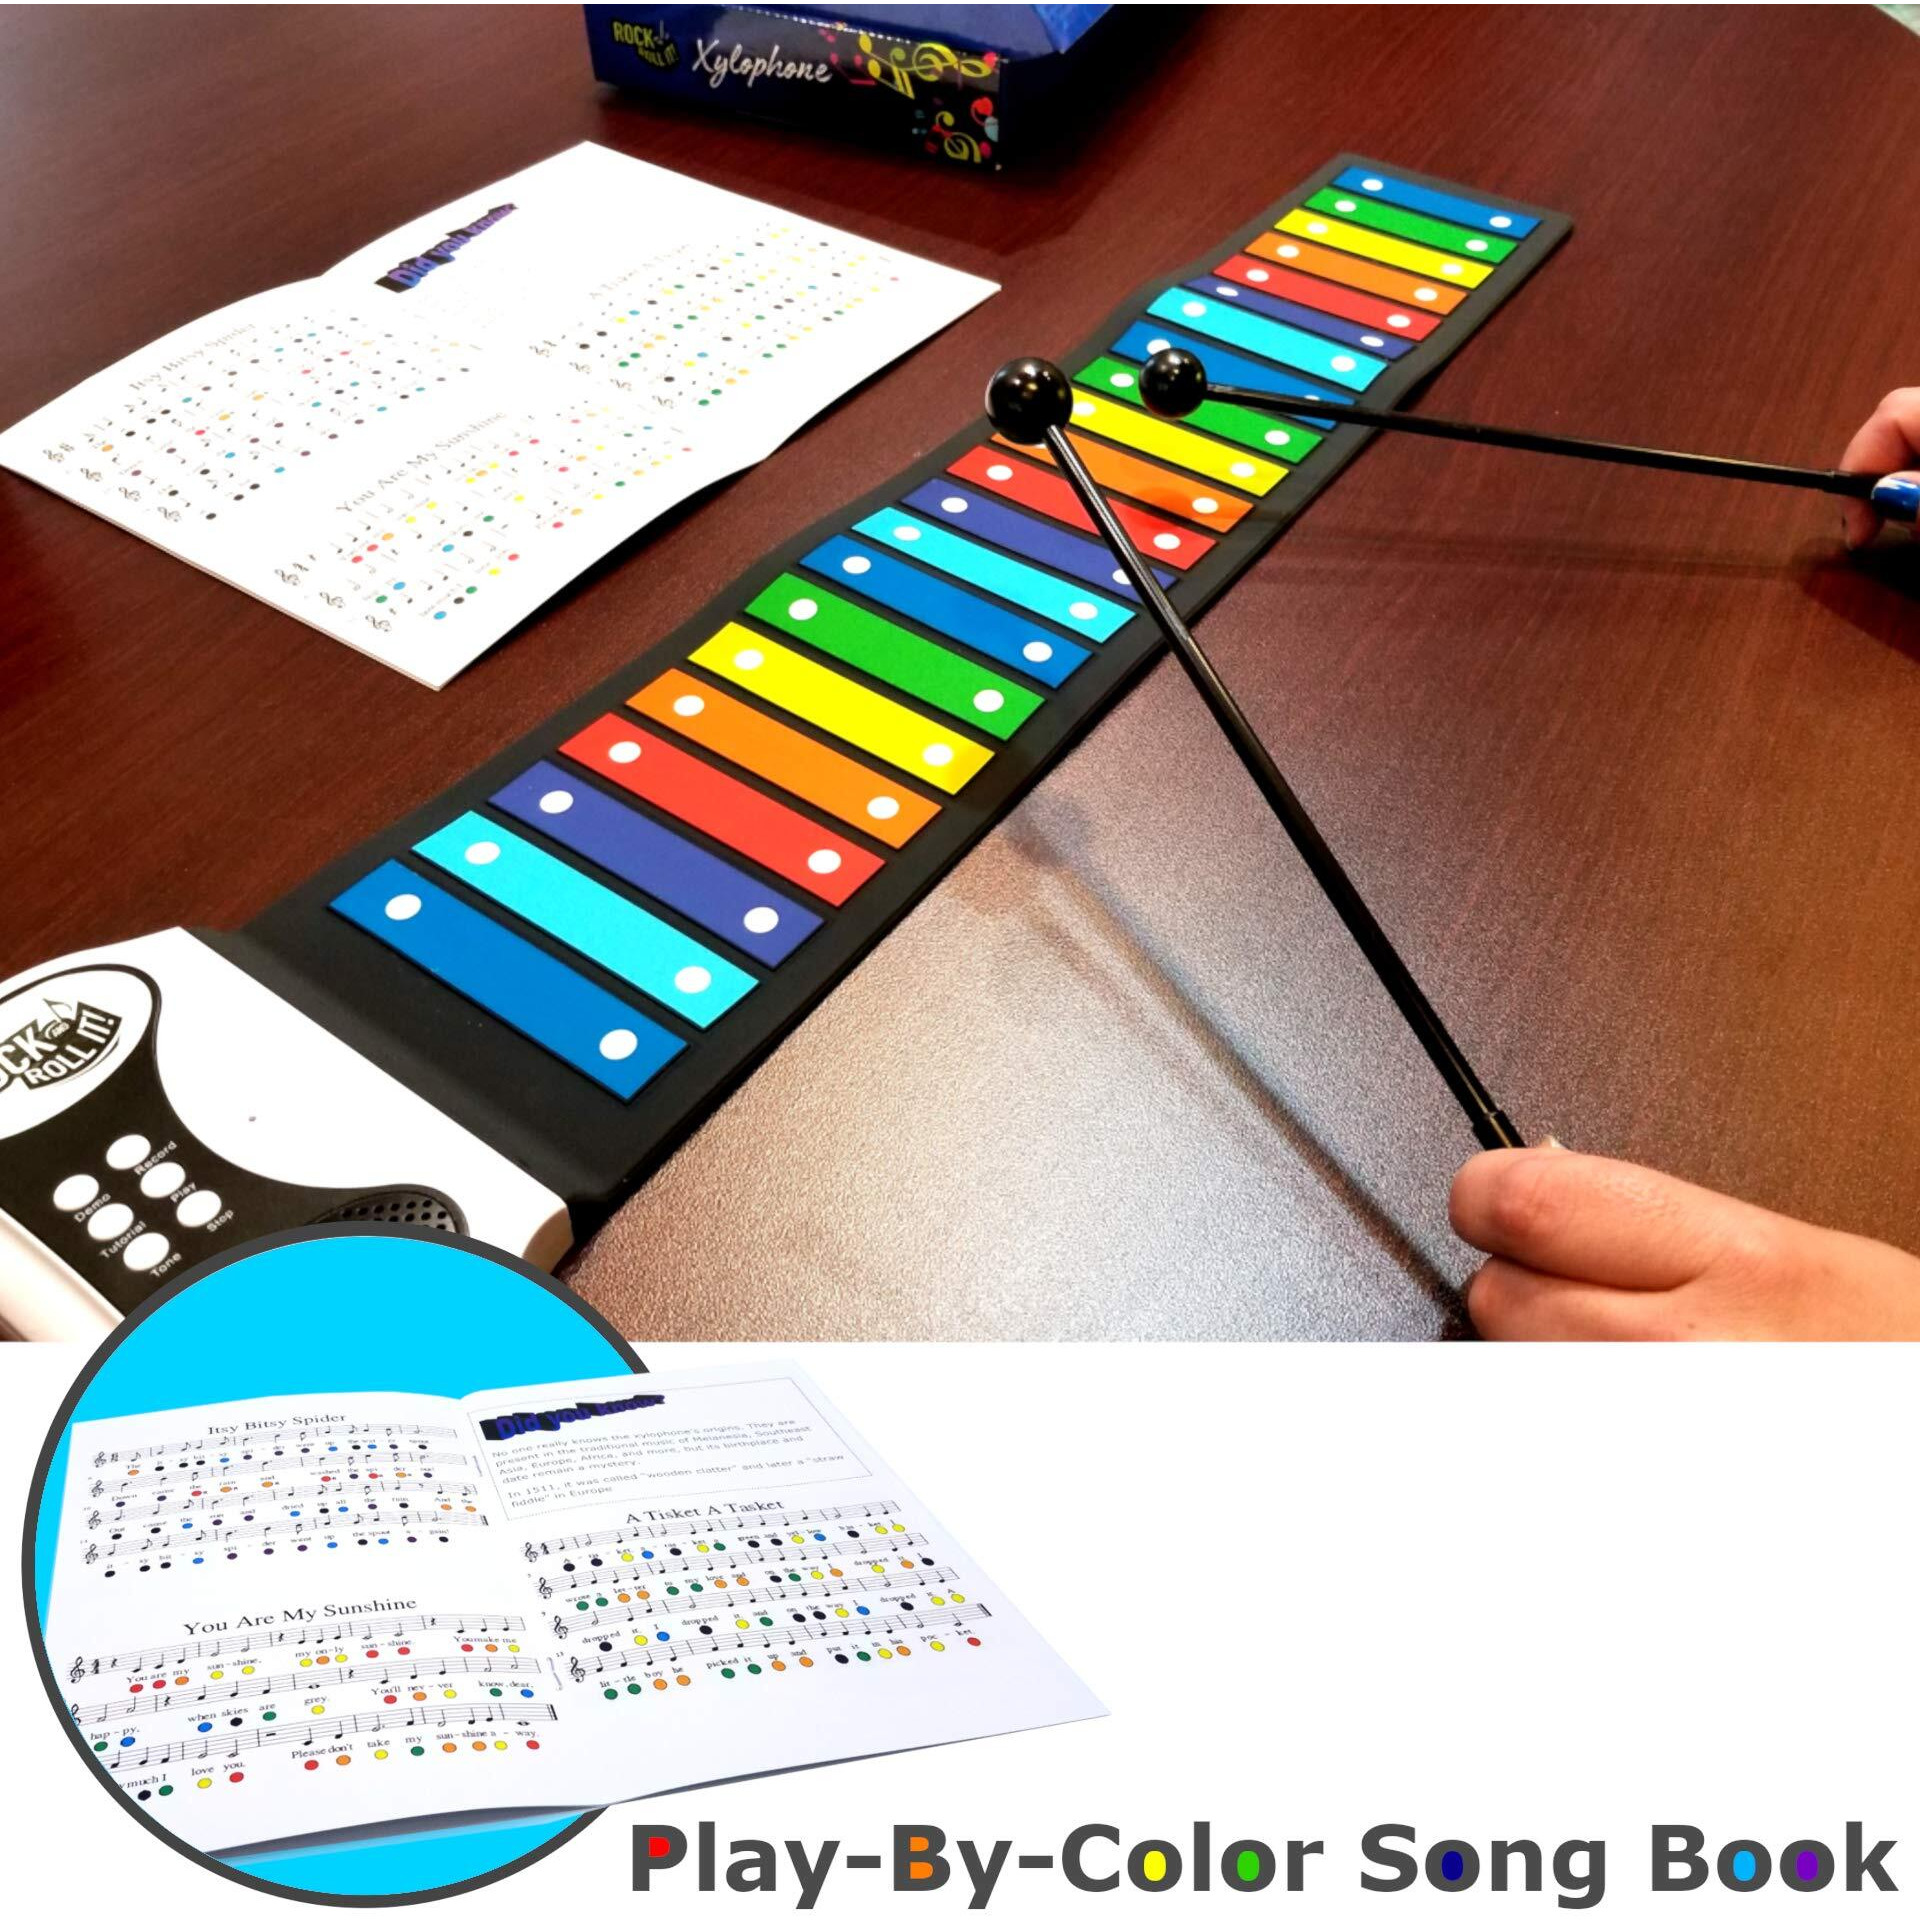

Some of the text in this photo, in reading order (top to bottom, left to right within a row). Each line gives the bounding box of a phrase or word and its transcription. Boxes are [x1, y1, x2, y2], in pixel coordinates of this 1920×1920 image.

[613, 21, 655, 47] ROCK
[692, 38, 833, 88] Xylophone
[336, 490, 375, 512] You
[378, 470, 408, 490] Are
[406, 452, 438, 469] My
[0, 1026, 58, 1085] CK
[24, 1009, 114, 1084] ROLL IT!
[133, 1140, 178, 1175] Record
[73, 1193, 112, 1223] Demo
[170, 1182, 197, 1203] Play
[206, 1209, 234, 1233] Stop
[100, 1221, 147, 1258] Tutorial
[151, 1253, 182, 1277] Tone
[208, 1414, 347, 1435] Itsy Bitsy Spider
[481, 1412, 542, 1440] Did
[543, 1407, 592, 1431] you
[512, 1445, 533, 1453] one
[537, 1440, 568, 1450] really
[572, 1436, 608, 1444] knows
[634, 1428, 710, 1441] xylophone's
[703, 1424, 744, 1433] origins.
[747, 1421, 773, 1430] They
[495, 1454, 540, 1468] present
[558, 1447, 576, 1455] the
[579, 1440, 638, 1453] traditional
[642, 1438, 675, 1447] music
[755, 1426, 812, 1437] Southeast
[723, 1438, 779, 1448] birthplace
[502, 1474, 528, 1484] date
[533, 1467, 574, 1477] remain
[589, 1461, 640, 1470] mystery.
[508, 1491, 520, 1499] In
[603, 1474, 637, 1483] called
[742, 1463, 763, 1471] and
[767, 1460, 792, 1468] later
[570, 1486, 612, 1498] Europe
[626, 1500, 784, 1524] A Tisket A Tasket
[184, 1598, 417, 1636] You Are My Sunshine
[127, 1674, 148, 1683] You
[150, 1671, 167, 1680] are
[173, 1668, 189, 1677] my
[295, 1650, 311, 1658] my
[644, 1670, 663, 1679] boy
[707, 1657, 740, 1669] picked
[90, 1730, 110, 1740] hap
[188, 1713, 217, 1723] when
[221, 1707, 249, 1717] skies
[371, 1685, 401, 1695] You'll
[127, 1775, 159, 1789] much
[162, 1774, 167, 1782] I
[191, 1766, 214, 1776] love
[223, 1761, 246, 1772] you.
[292, 1749, 326, 1759] Please
[328, 1744, 353, 1754] don't
[367, 1739, 390, 1748] take
[405, 1735, 422, 1744] my
